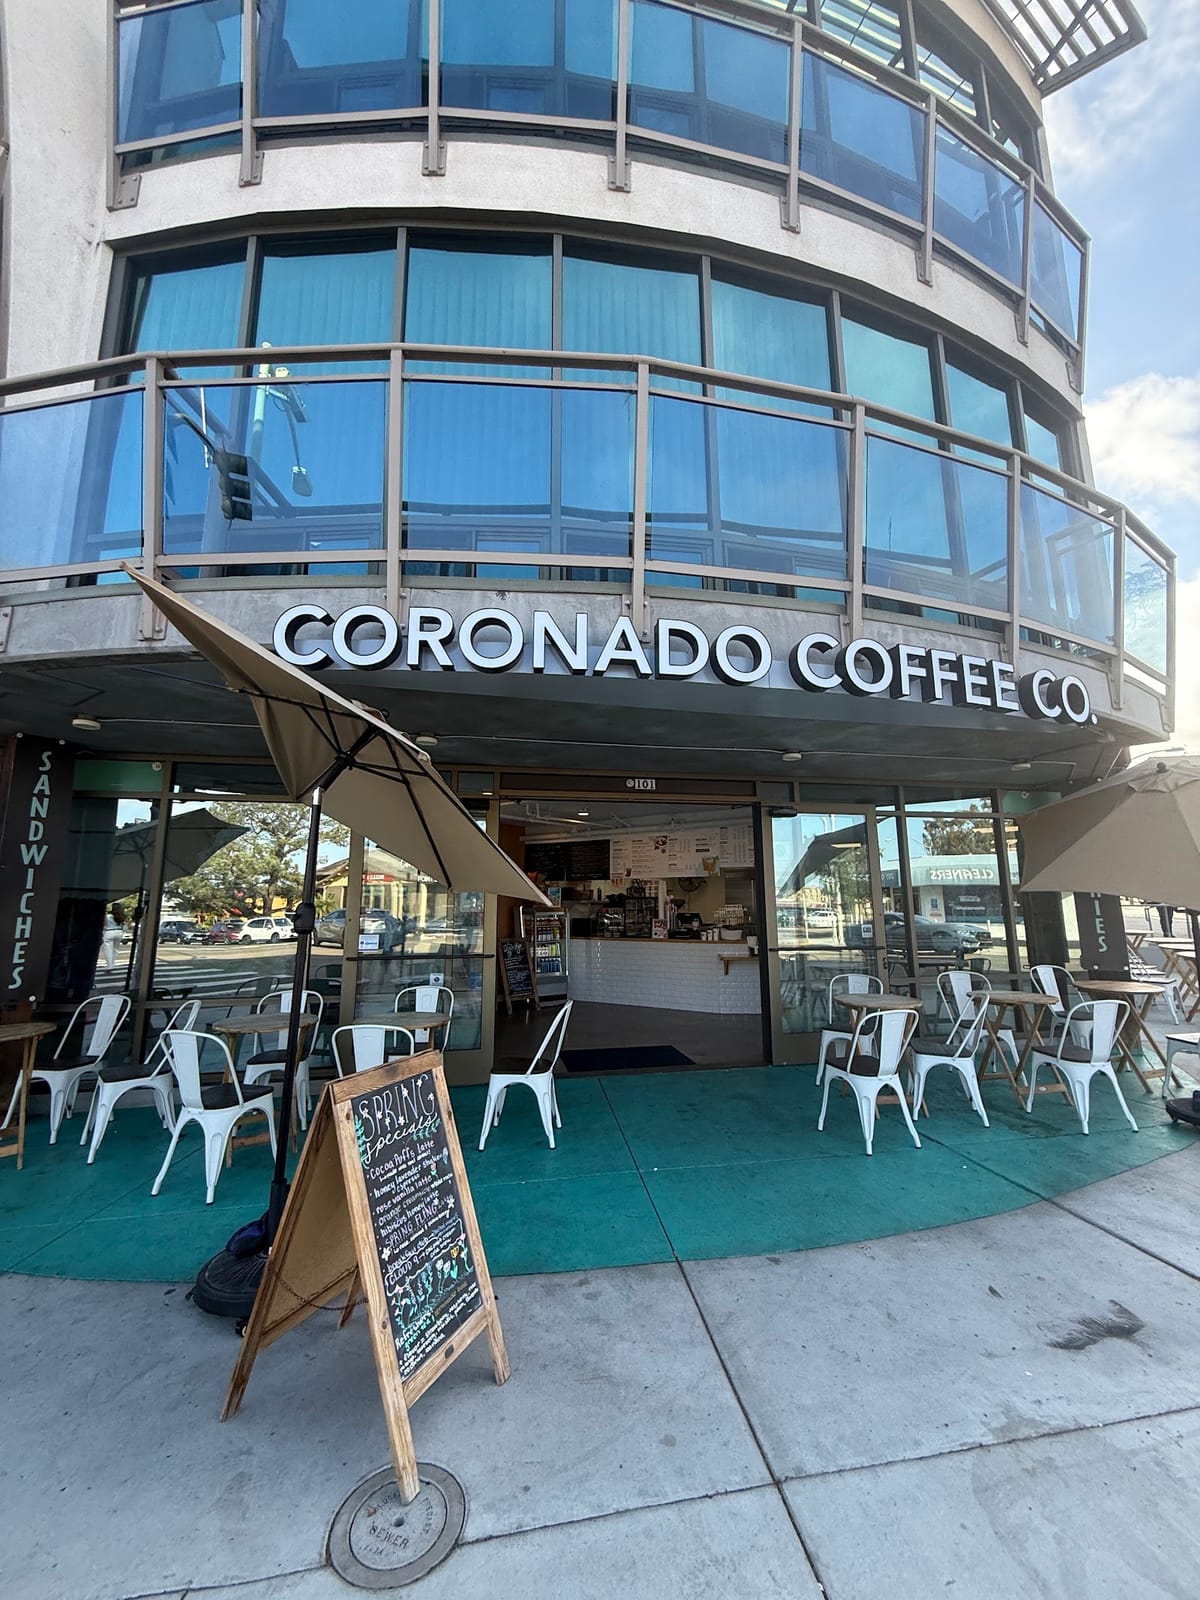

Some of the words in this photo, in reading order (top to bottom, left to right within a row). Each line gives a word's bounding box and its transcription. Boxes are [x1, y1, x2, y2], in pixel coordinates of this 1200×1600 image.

[273, 604, 774, 686] CORONADO
[790, 632, 1020, 712] COFFEE
[1019, 668, 1098, 727] CO.
[635, 779, 656, 790] 101
[8, 751, 52, 990] SANDWICHES
[359, 1074, 435, 1141] SPRING
[374, 1181, 397, 1199] honey
[395, 1164, 421, 1185] lavender
[392, 1186, 415, 1204] vanilla
[415, 1175, 432, 1188] latte
[385, 1221, 413, 1247] SPRING
[414, 1203, 438, 1229] FLING
[406, 1201, 425, 1218] honey
[389, 1261, 413, 1286] CLOUD
[369, 1524, 409, 1549] SEWER
